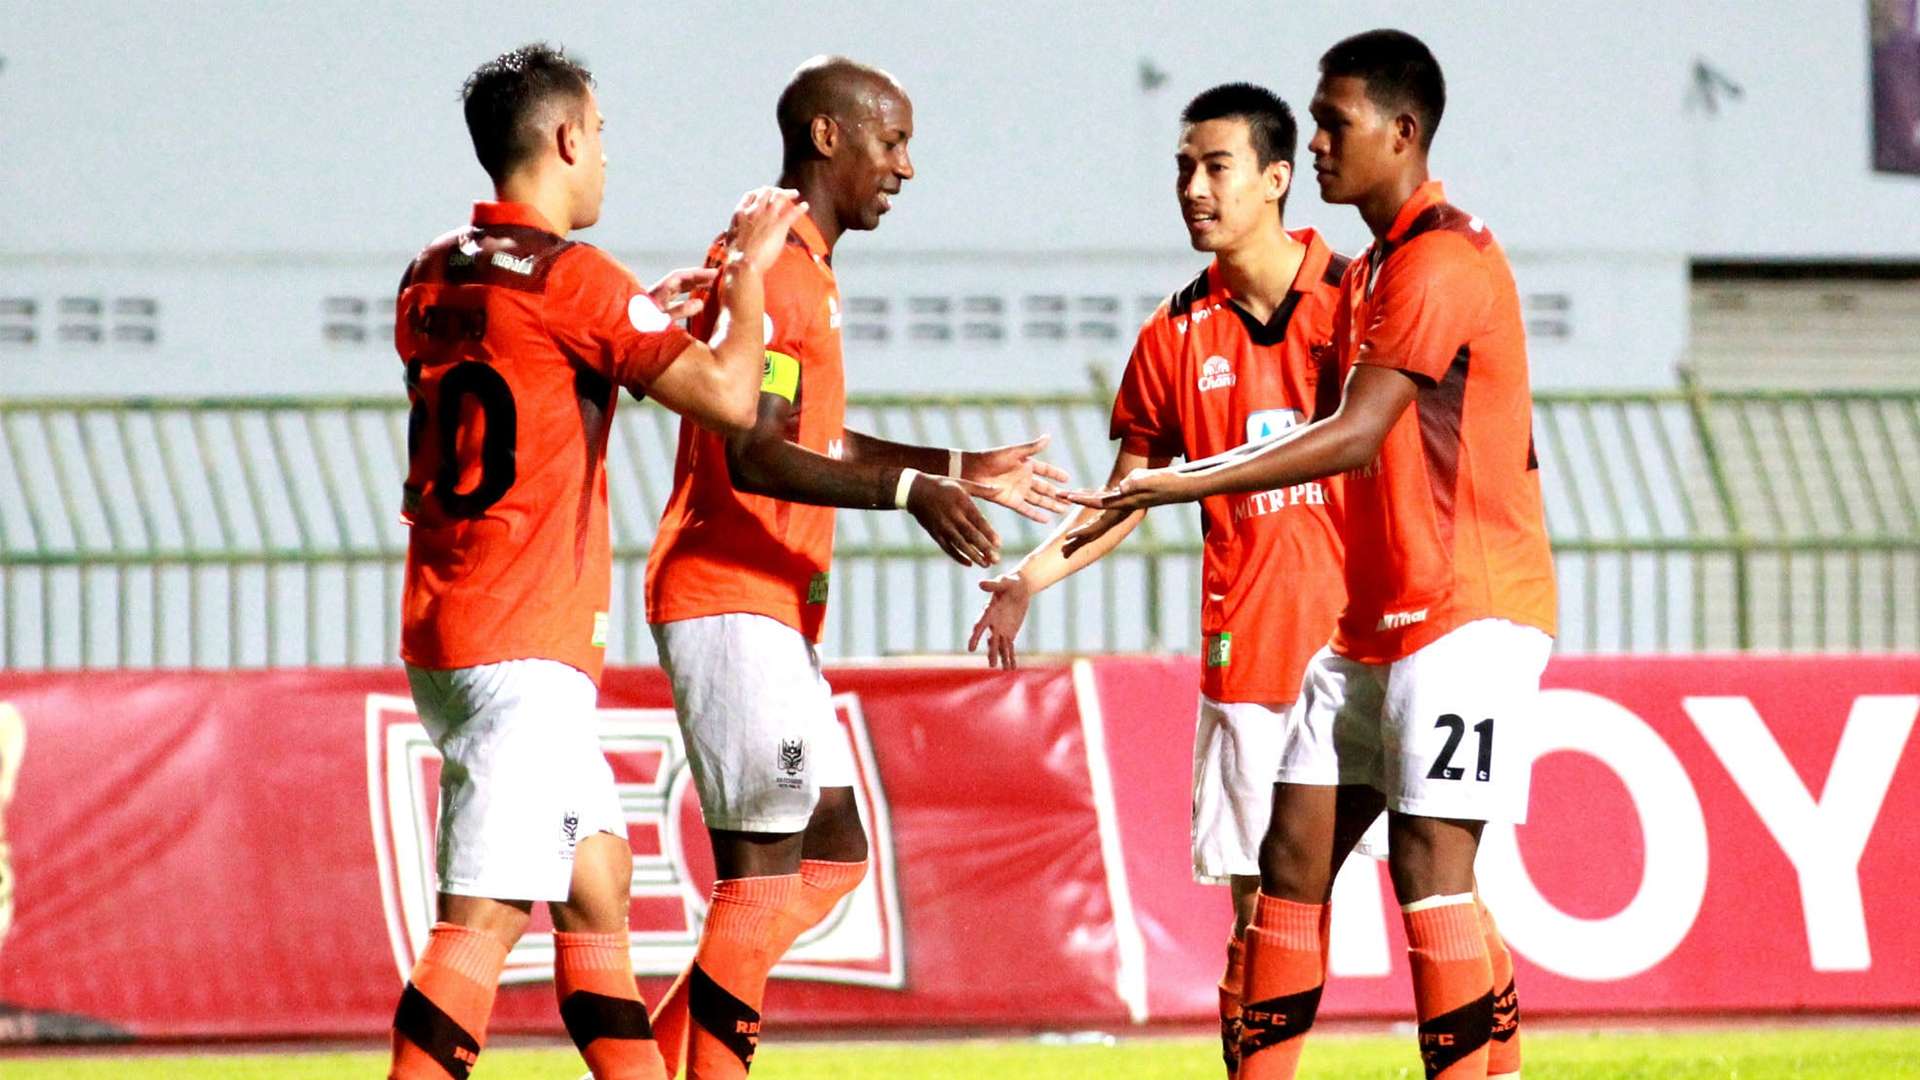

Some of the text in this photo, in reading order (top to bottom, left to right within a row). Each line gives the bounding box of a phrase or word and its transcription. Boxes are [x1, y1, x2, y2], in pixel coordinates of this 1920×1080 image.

[404, 355, 517, 521] 0
[1426, 713, 1494, 782] 21
[1329, 688, 1920, 981] OY
[1420, 1033, 1454, 1046] FC
